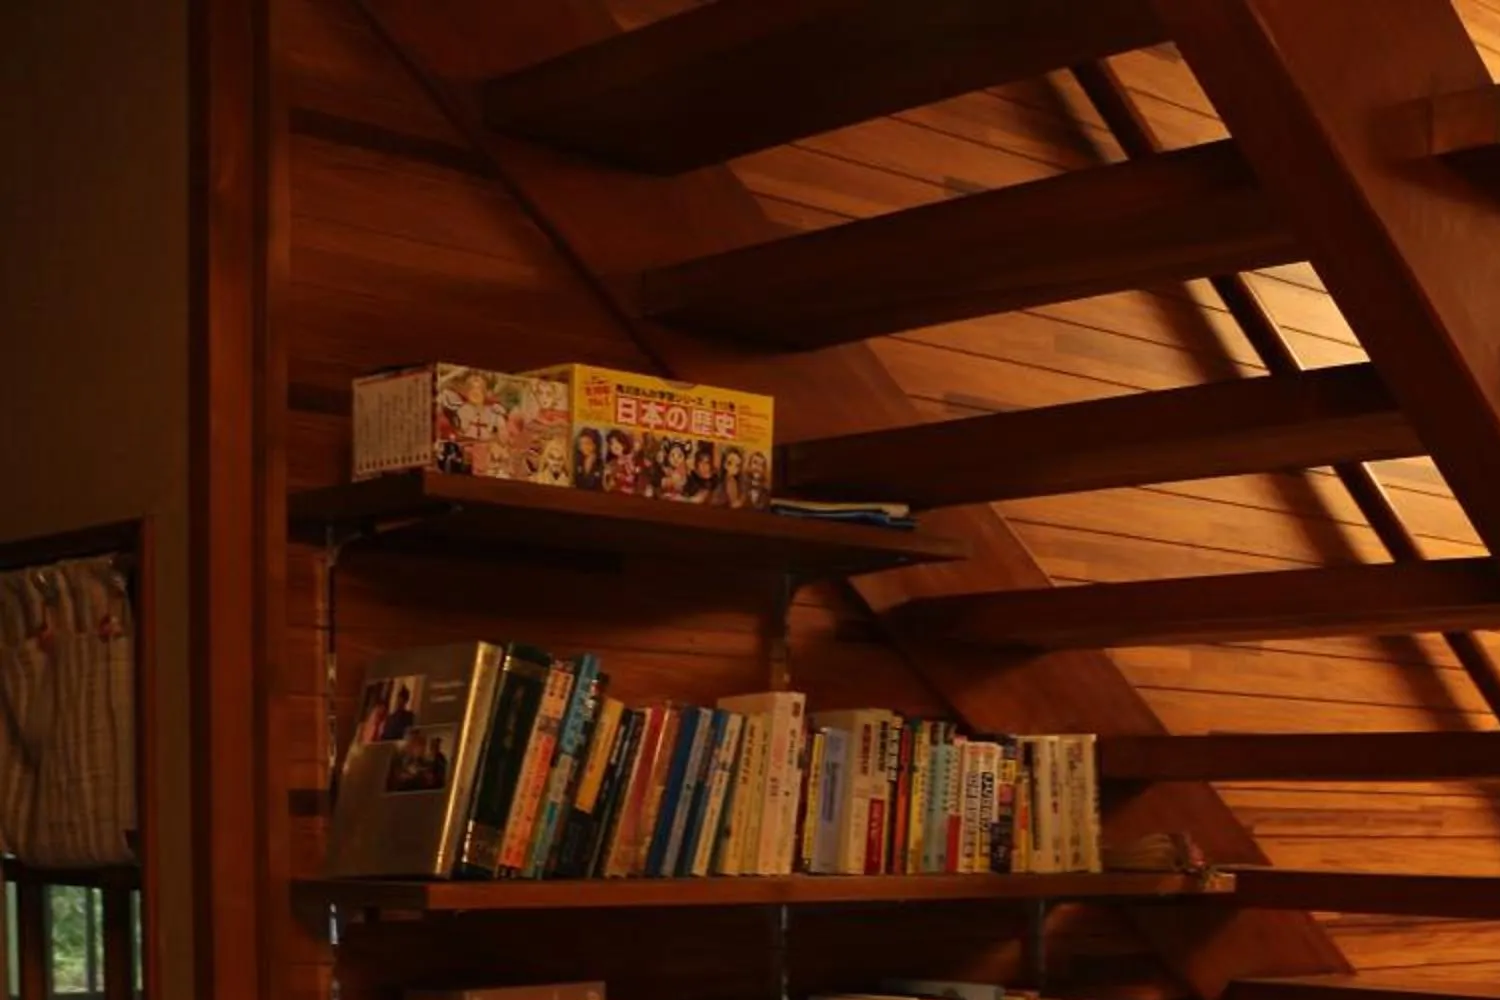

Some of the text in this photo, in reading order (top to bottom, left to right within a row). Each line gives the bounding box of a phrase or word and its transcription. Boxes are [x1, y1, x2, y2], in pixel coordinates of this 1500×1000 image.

[616, 396, 737, 438] 日本の歴史
